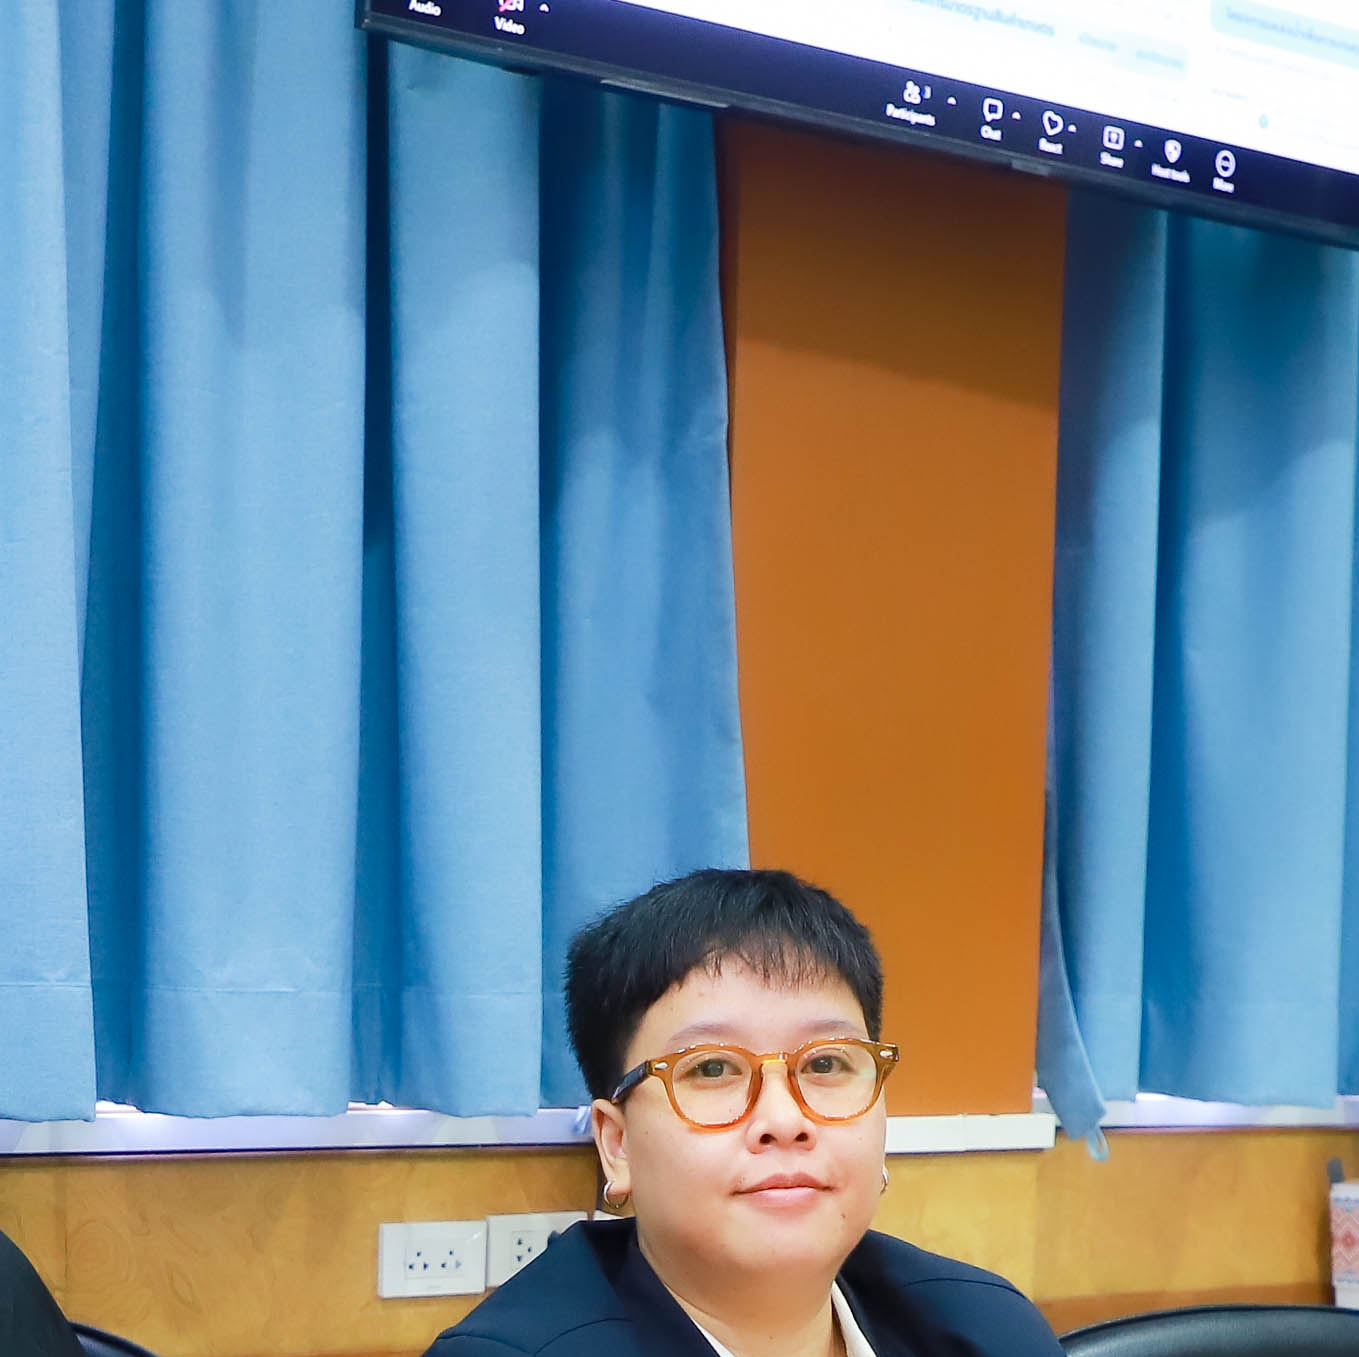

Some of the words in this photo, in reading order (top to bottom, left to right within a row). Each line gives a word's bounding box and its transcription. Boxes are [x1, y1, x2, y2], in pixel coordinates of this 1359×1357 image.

[408, 0, 442, 16] Audio
[494, 16, 525, 35] Video
[980, 125, 1002, 141] Chat
